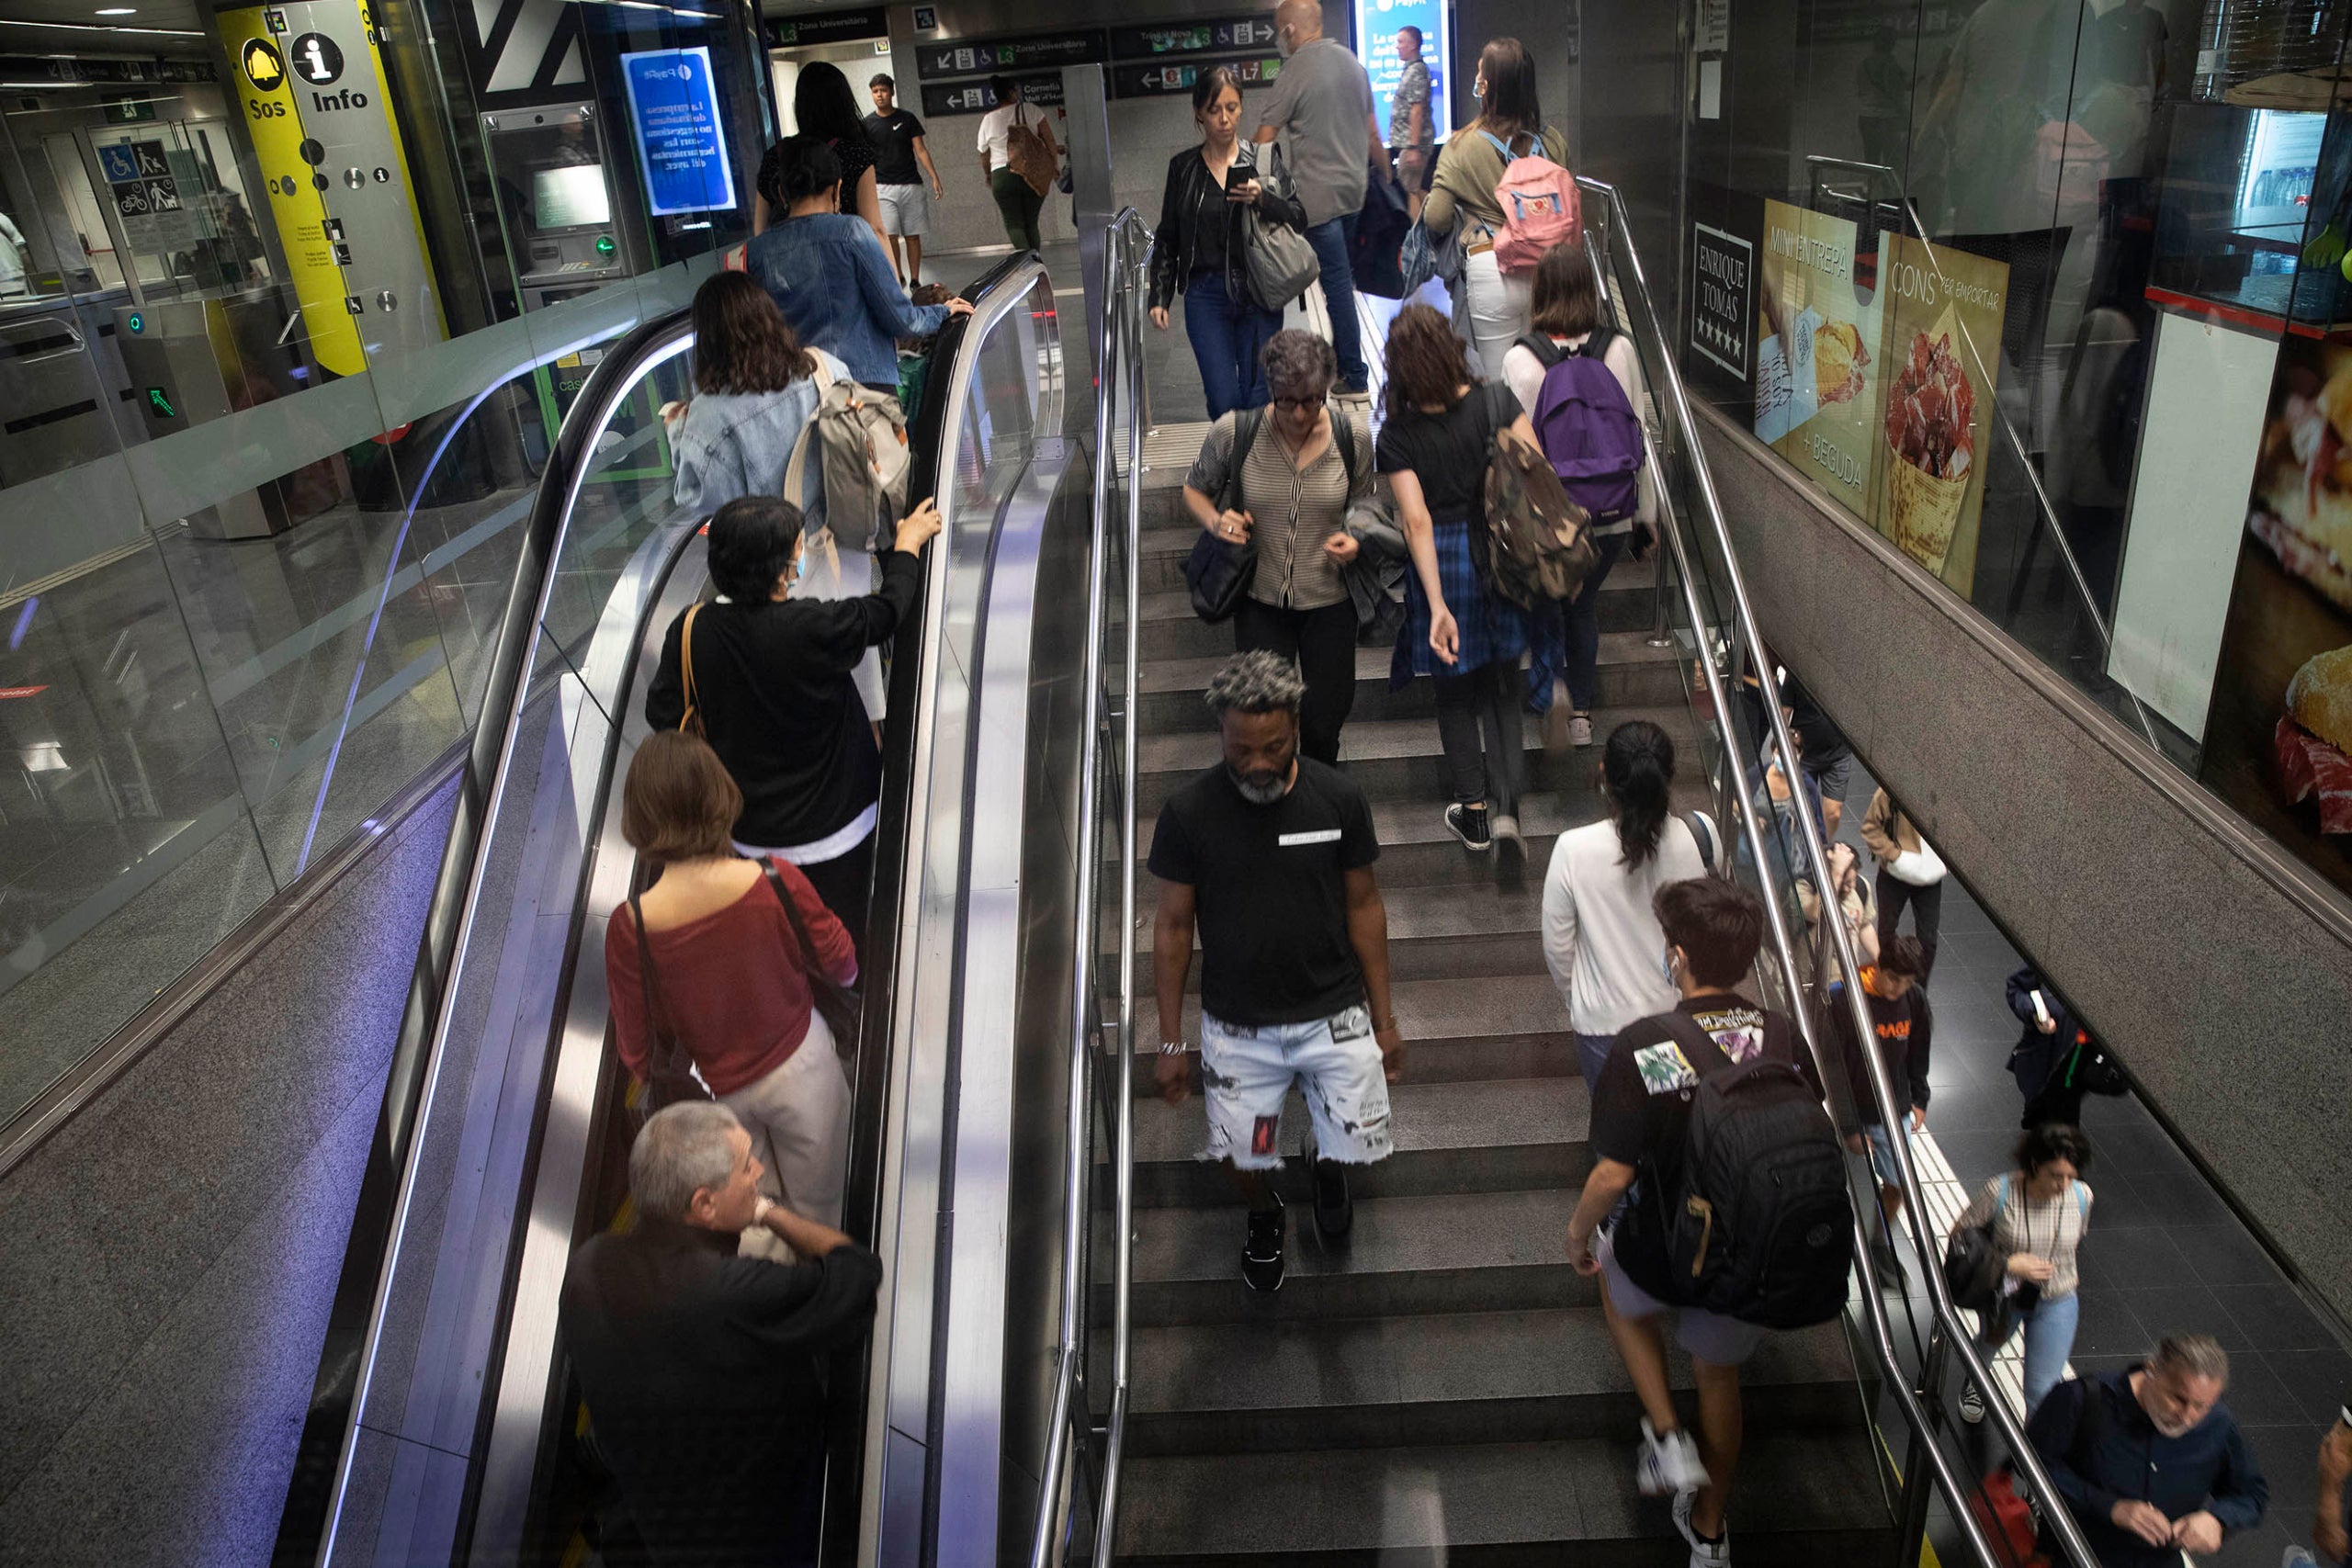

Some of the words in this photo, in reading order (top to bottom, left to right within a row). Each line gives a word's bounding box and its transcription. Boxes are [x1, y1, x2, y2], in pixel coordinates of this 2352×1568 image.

[780, 28, 797, 42] L3
[798, 22, 819, 30] Zona
[997, 50, 1014, 65] L3
[1015, 44, 1036, 53] Zona
[1242, 67, 1259, 81] L7
[249, 98, 287, 120] Sos
[312, 88, 368, 113] Info
[1770, 225, 1794, 259] MINI
[1700, 244, 1745, 290] ENRIQUE
[1891, 261, 1937, 305] CONS
[1940, 276, 1954, 296] PER
[1955, 281, 2000, 312] EMPORTAR
[1702, 280, 1738, 322] TOMAS
[1771, 353, 1781, 371] YO
[559, 377, 583, 392] cas
[1771, 376, 1782, 409] SOY
[1813, 434, 1863, 494] BEGUDA
